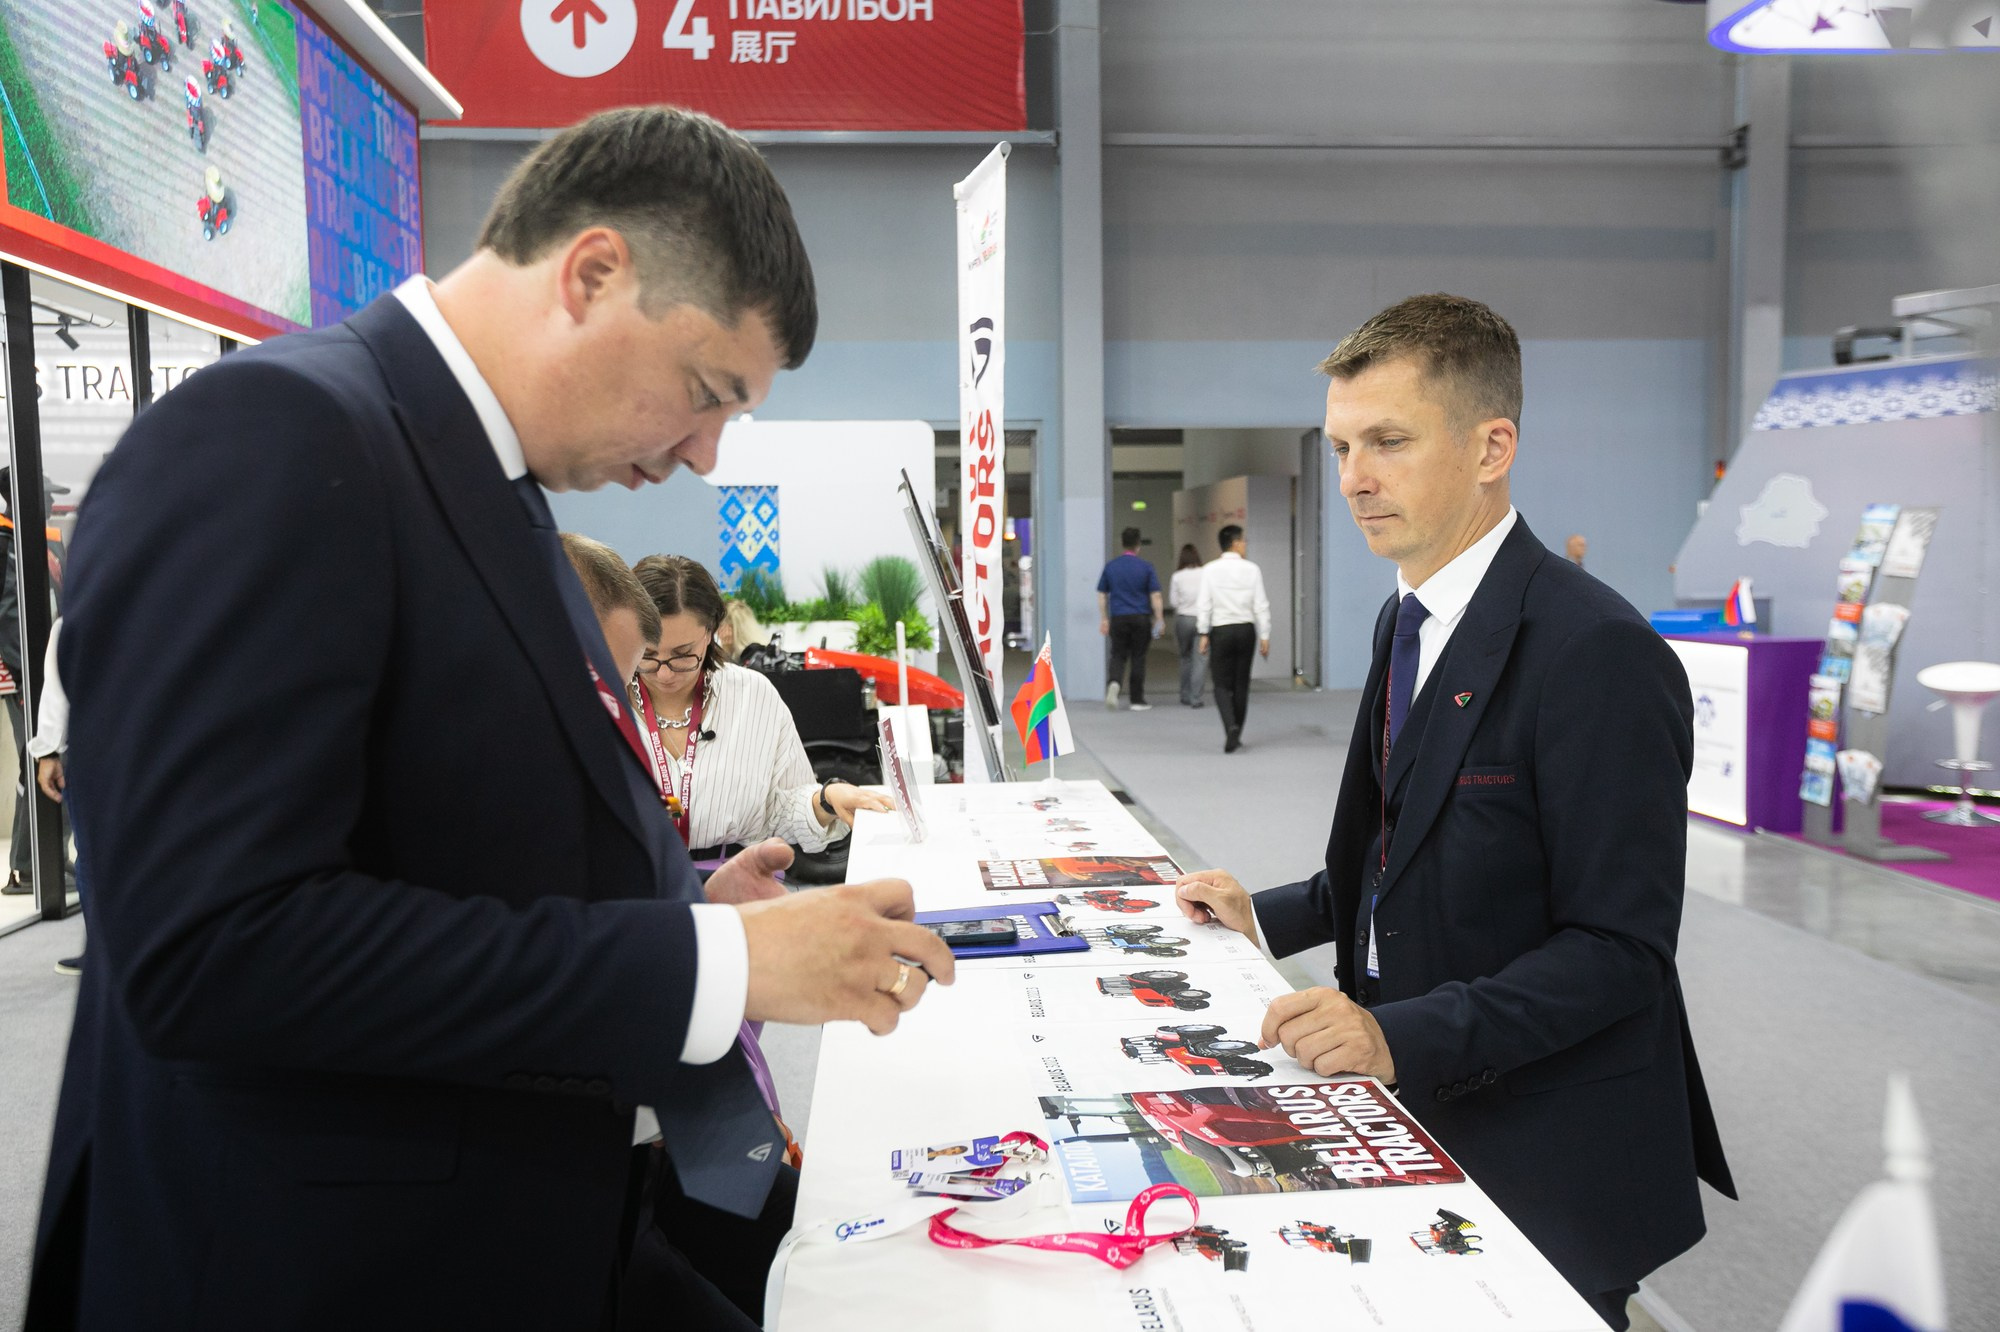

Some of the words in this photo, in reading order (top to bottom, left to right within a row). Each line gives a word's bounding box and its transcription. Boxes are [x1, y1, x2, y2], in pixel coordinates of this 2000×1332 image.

[663, 0, 715, 60] 4
[729, 30, 797, 64] 展厅
[1473, 775, 1516, 785] TRACTORS
[1047, 1068, 1073, 1092] BELARUS
[1267, 1085, 1388, 1180] BELARUS
[1318, 1083, 1443, 1176] TRACTORS
[1059, 1139, 1108, 1192] КАТАЛОГ
[1129, 1288, 1165, 1332] ELARUS
